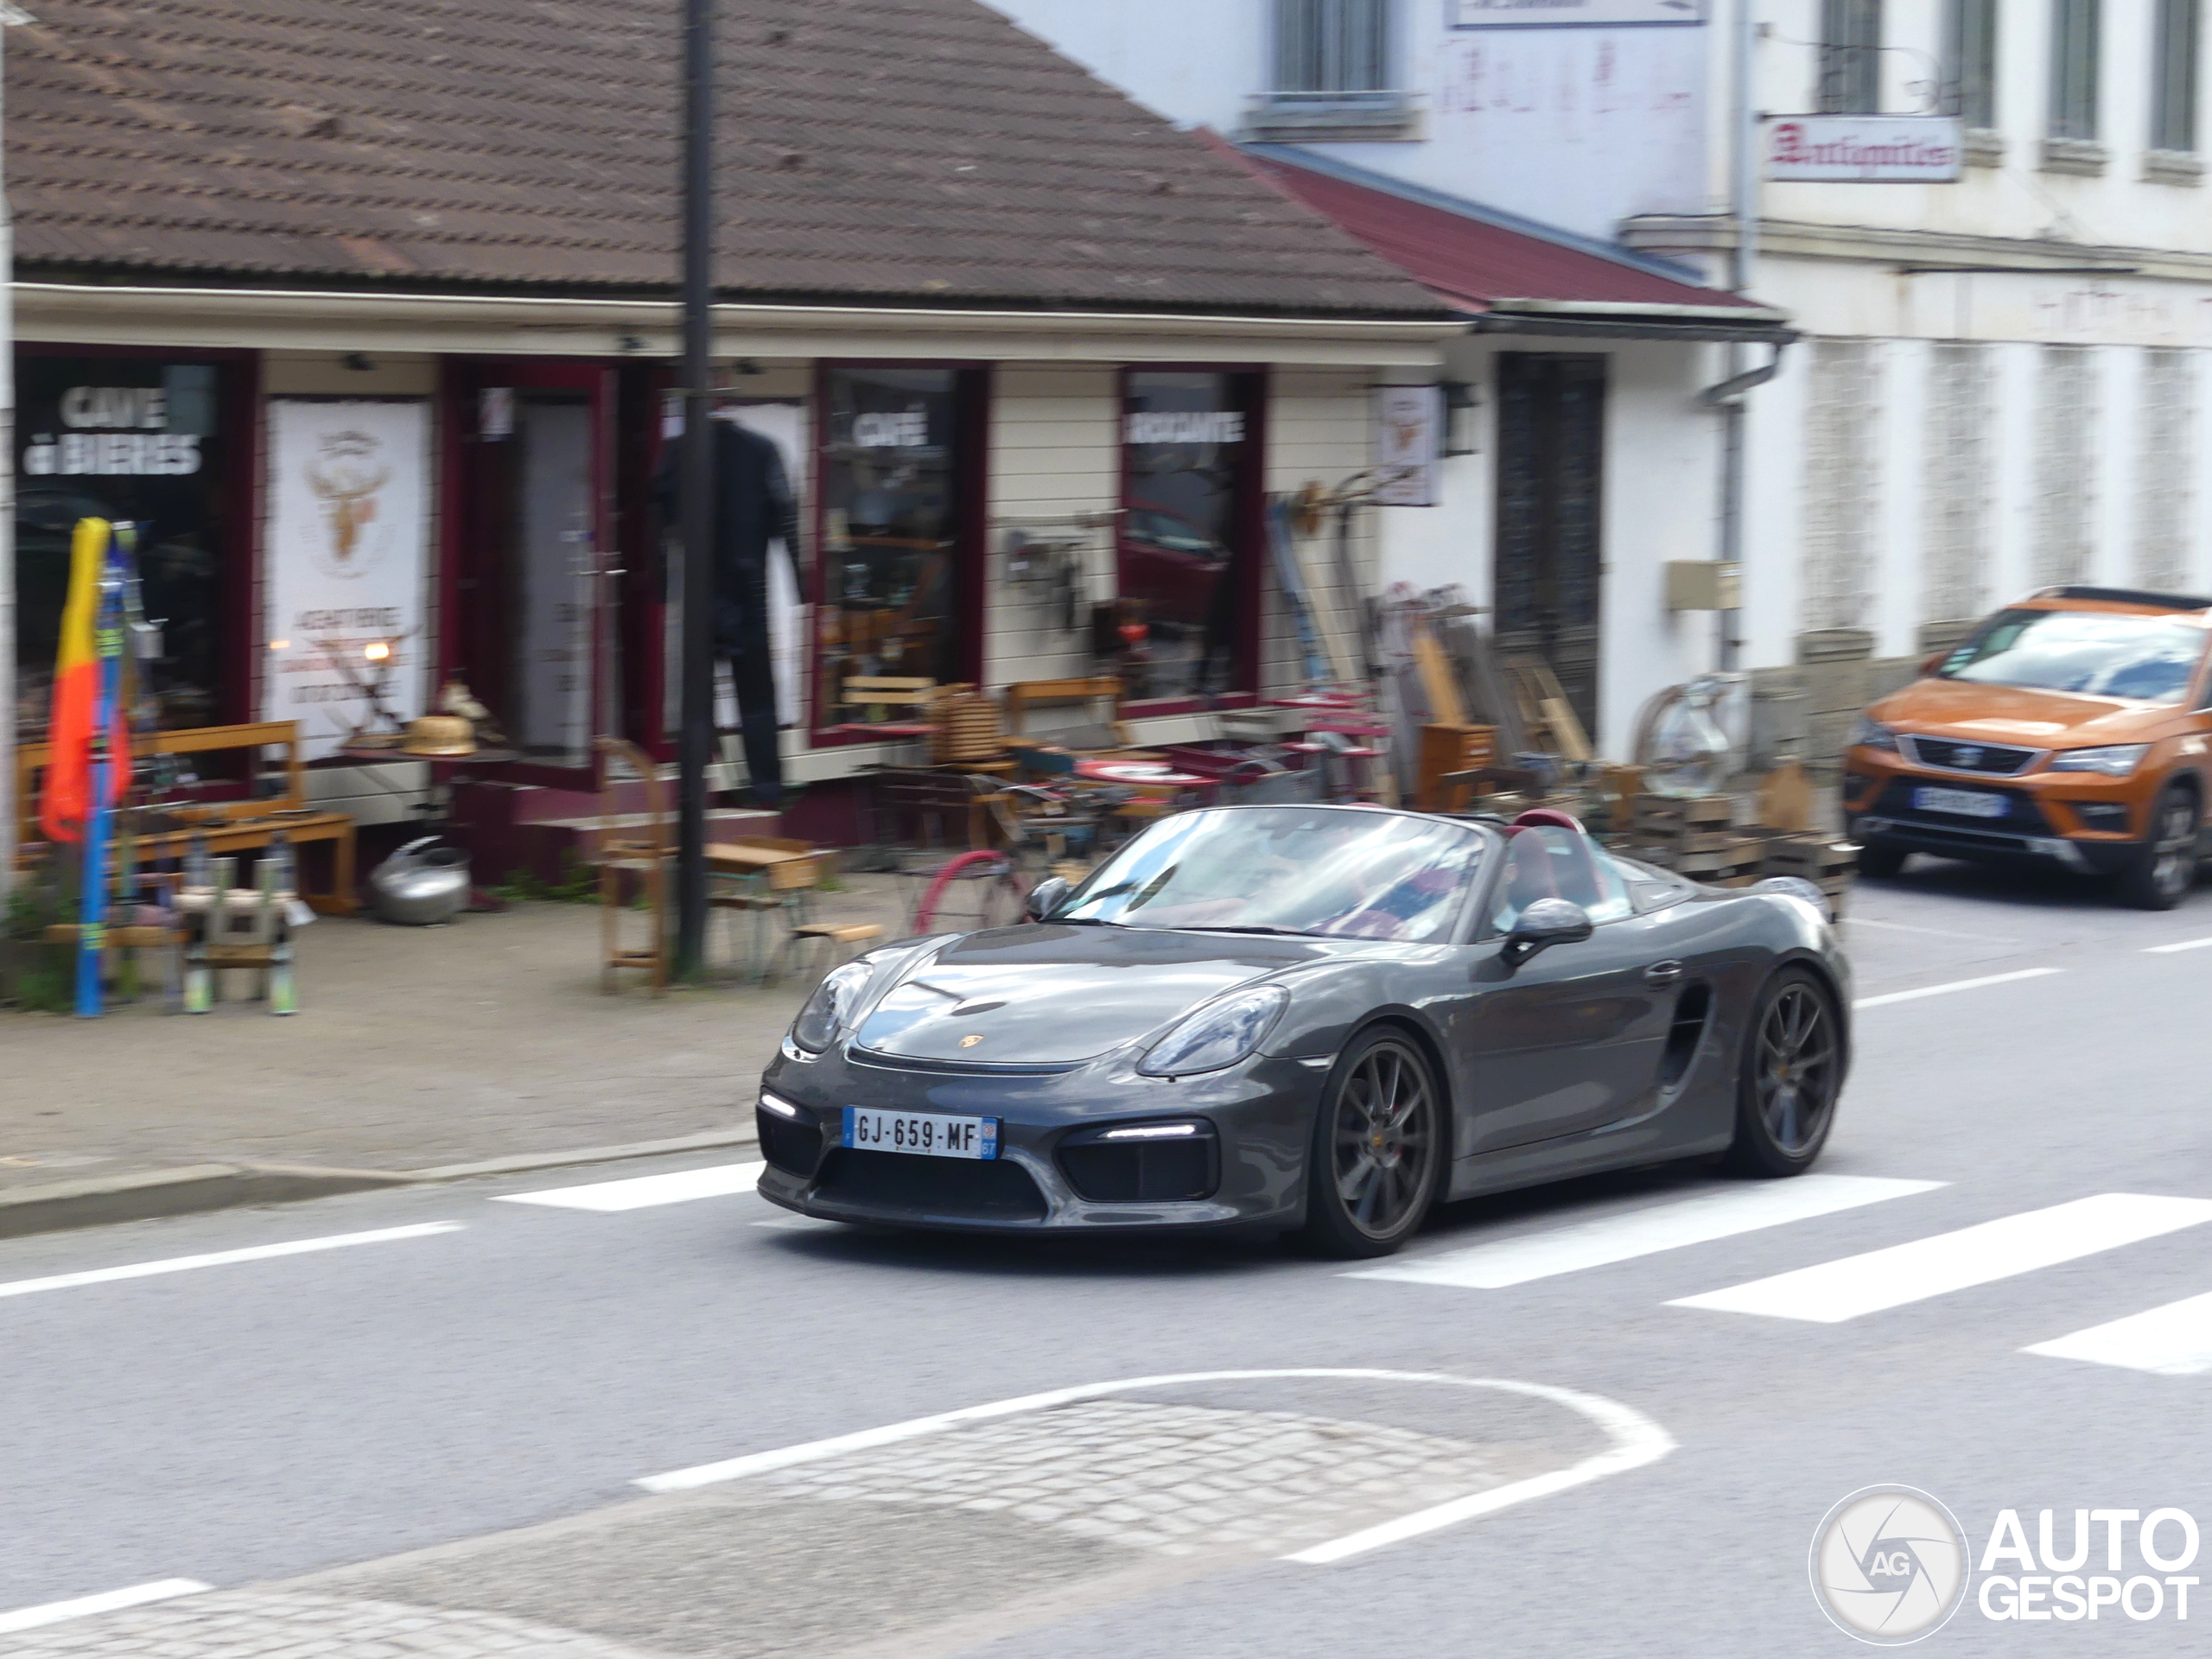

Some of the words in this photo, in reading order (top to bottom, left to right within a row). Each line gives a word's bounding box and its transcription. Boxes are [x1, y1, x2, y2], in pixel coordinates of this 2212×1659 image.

[60, 386, 169, 428] CAVE
[858, 1115, 976, 1151] GJ-659-MF
[982, 1142, 996, 1155] 67
